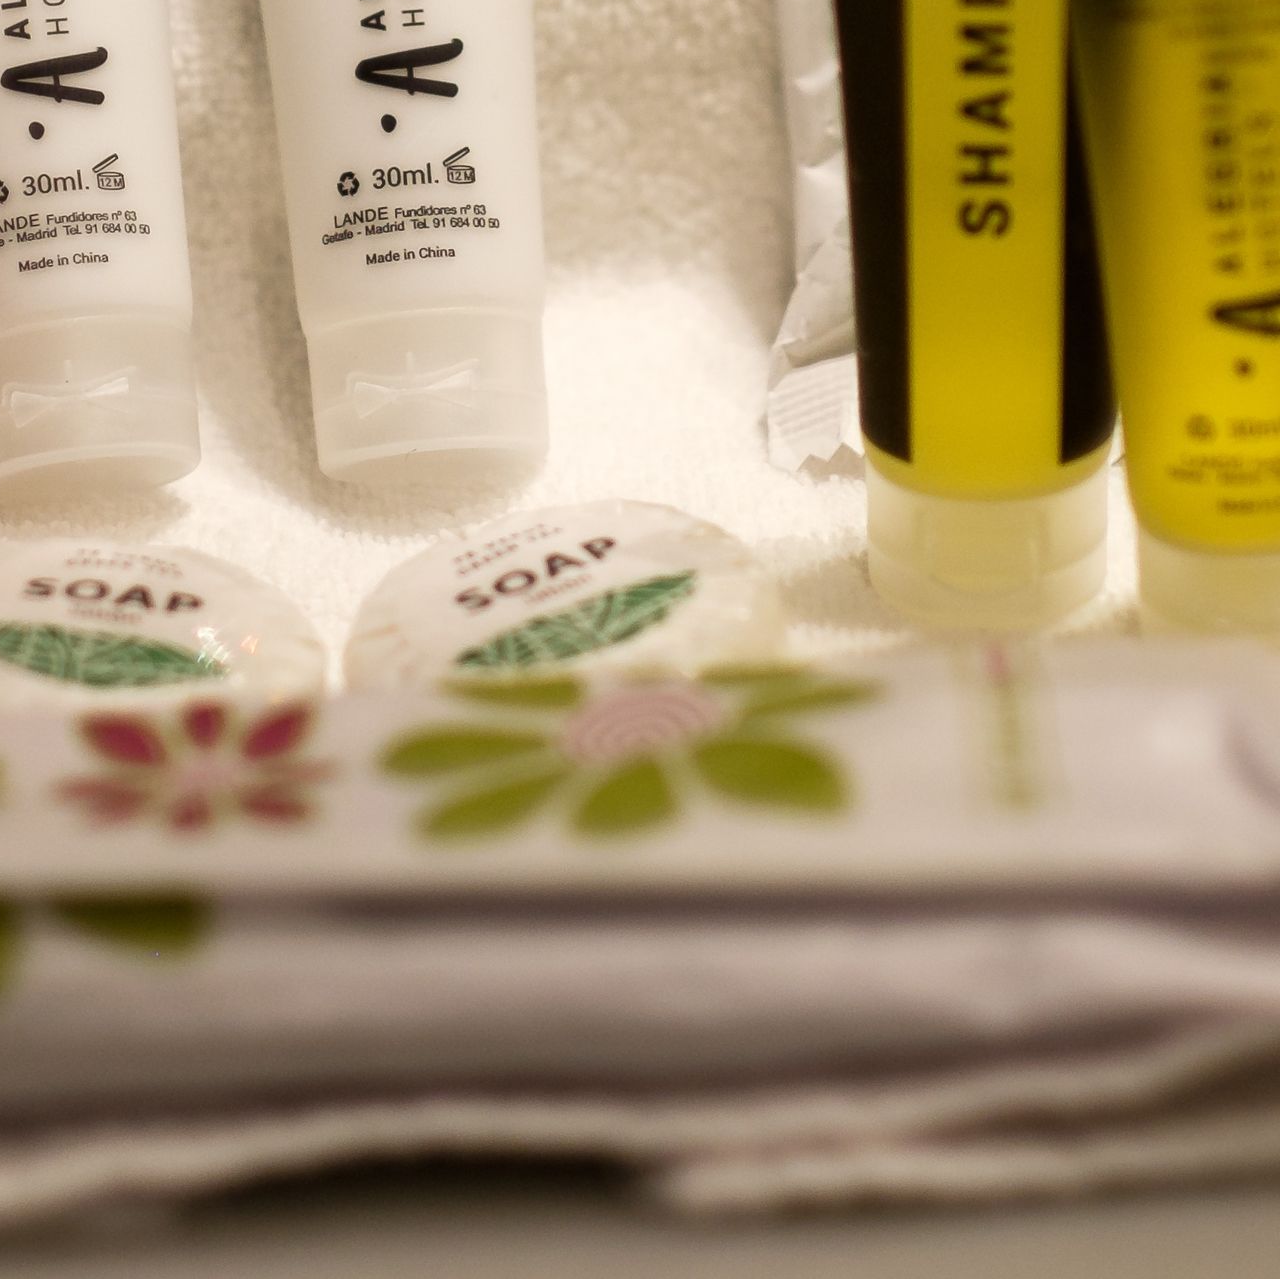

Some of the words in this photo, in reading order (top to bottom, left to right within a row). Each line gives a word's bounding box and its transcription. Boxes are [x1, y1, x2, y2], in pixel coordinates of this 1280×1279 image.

[21, 169, 90, 197] 30ml.
[372, 162, 439, 190] 30ml.
[46, 211, 109, 225] Fundidores
[124, 210, 137, 222] 63
[333, 206, 389, 229] LANDE
[394, 205, 458, 219] Fundidores
[473, 204, 487, 216] 63
[16, 227, 58, 243] Madrid
[85, 223, 98, 234] 91
[102, 222, 121, 233] 684
[124, 223, 137, 234] 00
[139, 224, 151, 235] 50
[322, 229, 354, 246] Getafe
[365, 221, 405, 236] Madrid
[432, 218, 446, 229] 91
[450, 217, 470, 228] 684
[472, 217, 486, 228] 00
[18, 257, 54, 272] Made
[57, 254, 69, 266] in
[72, 251, 109, 265] China
[365, 250, 400, 266] Made
[403, 248, 415, 261] in
[419, 246, 456, 259] China
[454, 536, 616, 612] SOAP
[23, 577, 205, 611] SOAP
